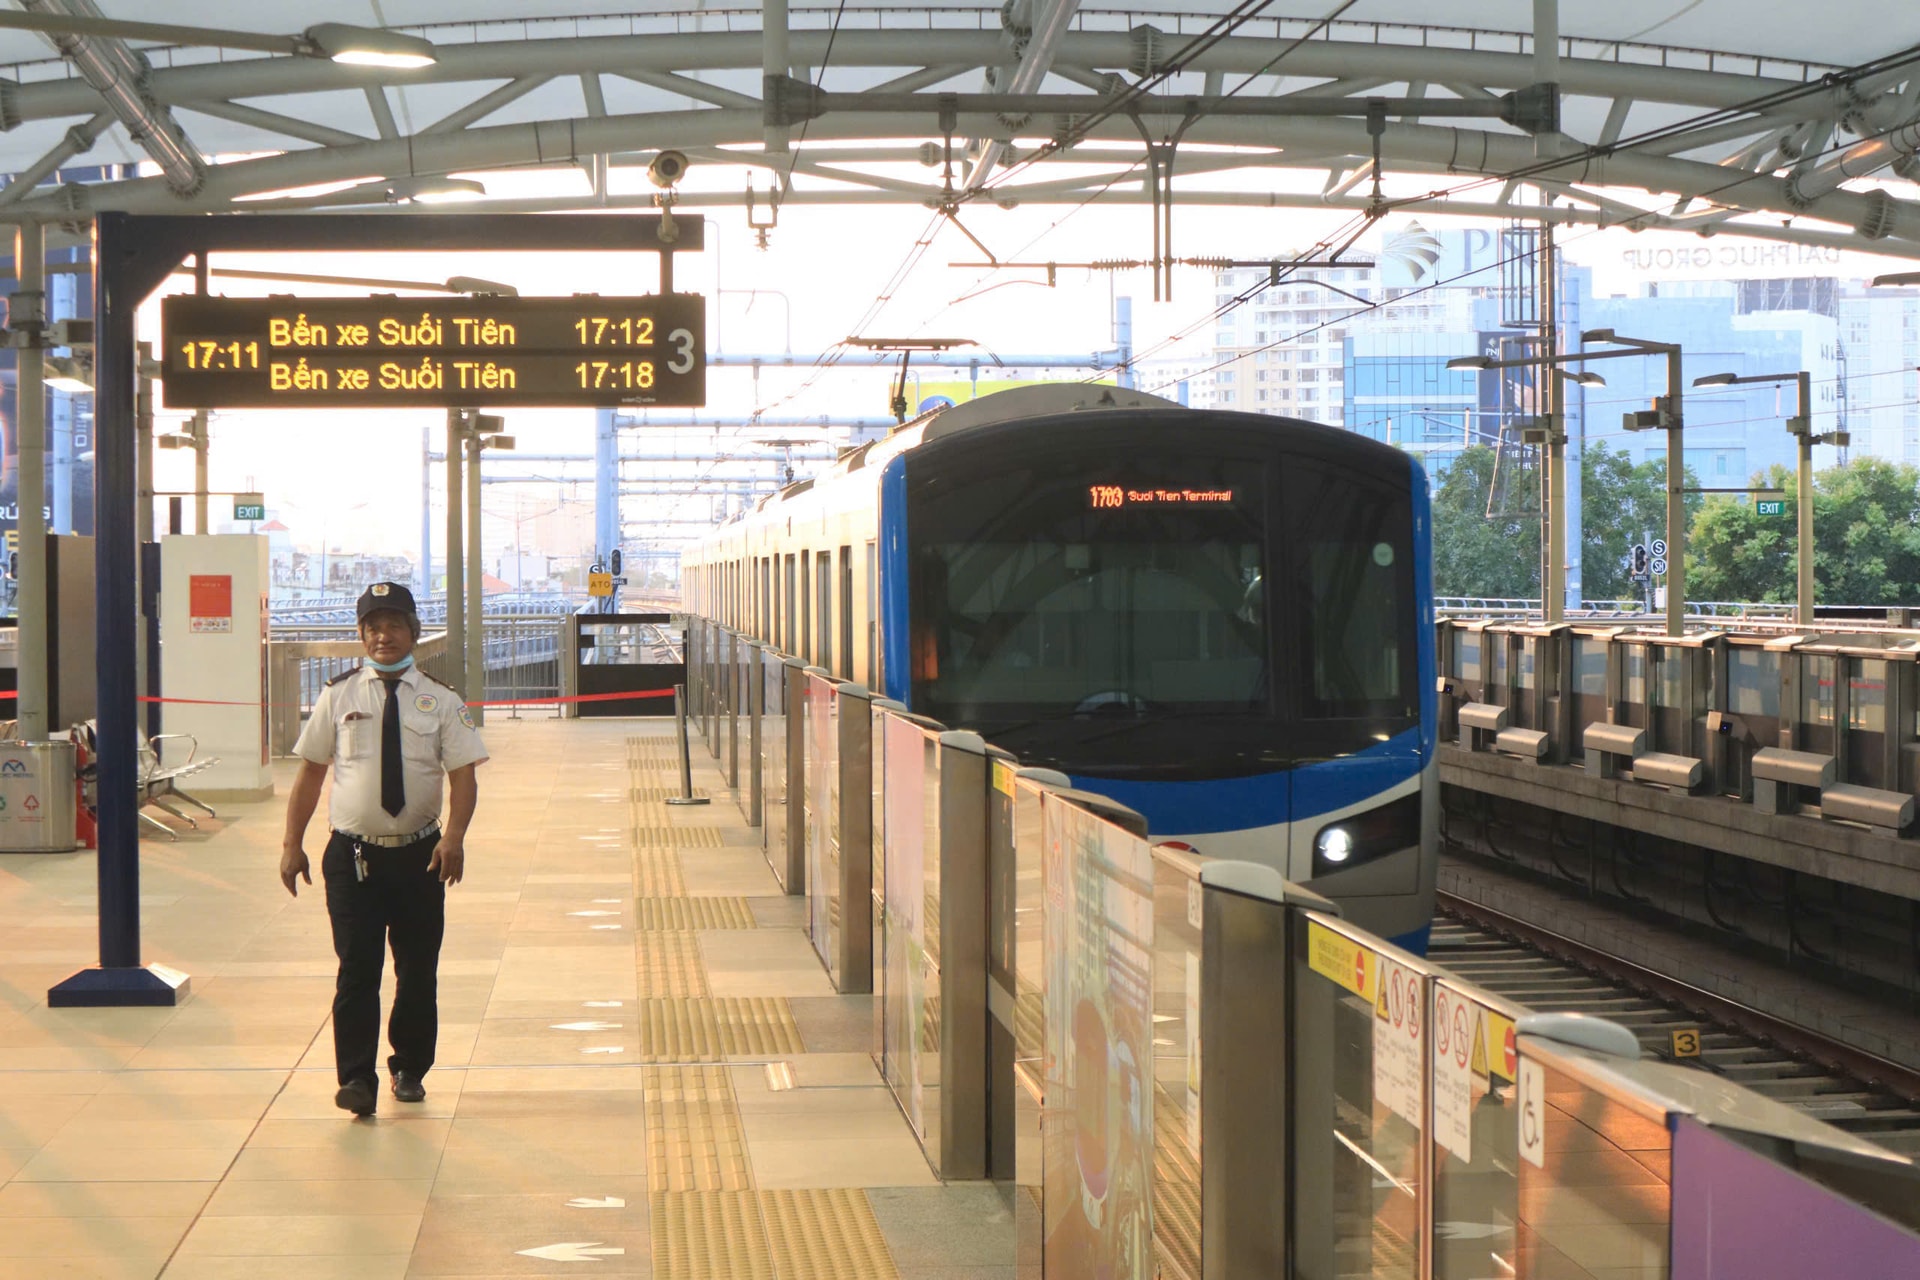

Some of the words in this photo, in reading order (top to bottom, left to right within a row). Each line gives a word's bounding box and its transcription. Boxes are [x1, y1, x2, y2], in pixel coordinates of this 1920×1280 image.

[270, 313, 328, 346] Bến
[336, 324, 369, 346] xe
[378, 312, 442, 346] Suối
[453, 318, 516, 346] Tiên
[575, 318, 654, 345] 17:12
[182, 341, 259, 369] 17:11
[667, 328, 694, 374] 3
[270, 357, 328, 390] Bến
[336, 368, 370, 390] xe
[378, 356, 442, 390] Suối
[453, 362, 516, 390] Tiên
[575, 362, 654, 389] 17:18
[1182, 490, 1232, 502] Terminal
[1759, 502, 1780, 514] EXIT
[238, 506, 260, 518] EXIT
[1677, 1033, 1697, 1054] 3
